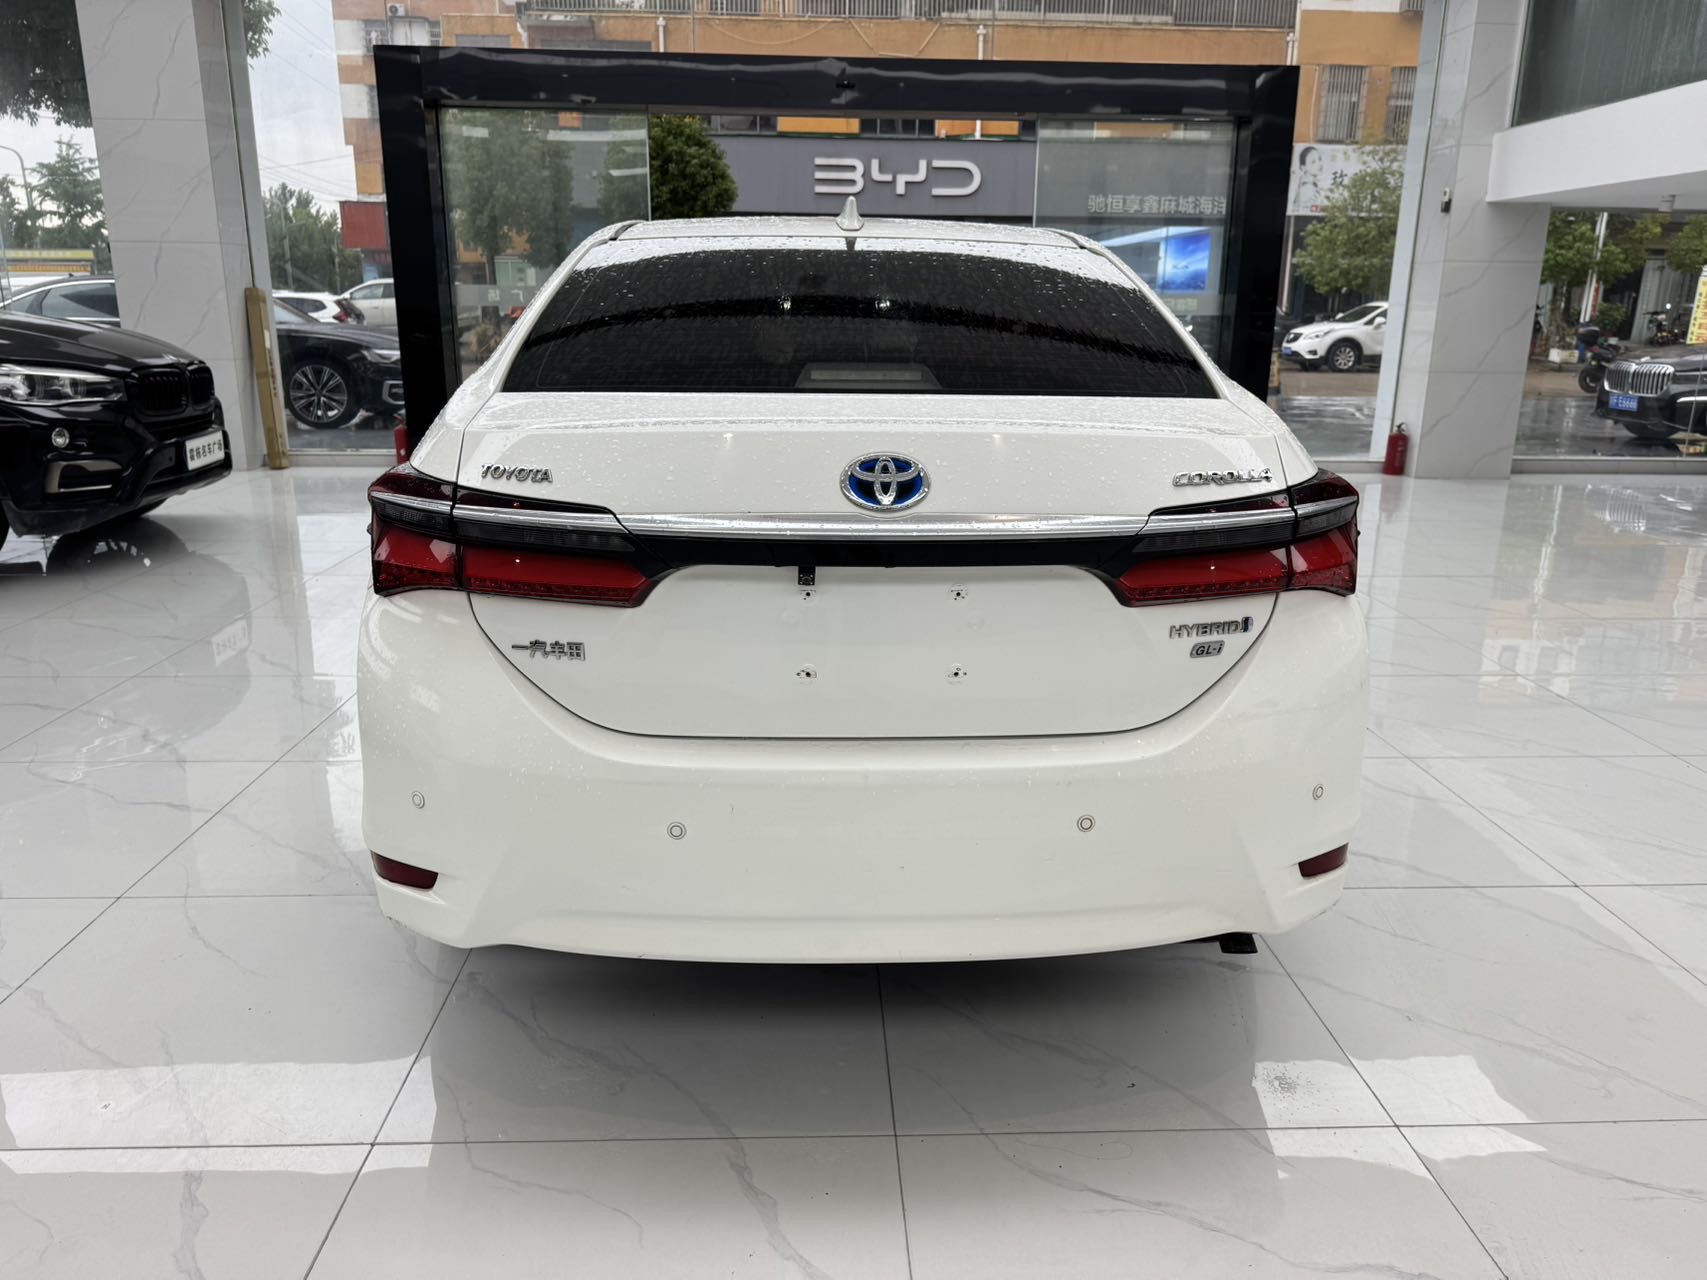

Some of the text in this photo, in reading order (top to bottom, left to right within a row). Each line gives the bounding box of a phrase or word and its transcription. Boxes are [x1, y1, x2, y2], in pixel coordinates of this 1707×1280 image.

[814, 157, 982, 196] BYD
[481, 464, 553, 483] TOYOTA
[1172, 468, 1272, 486] COROLLA
[1195, 643, 1223, 656] GL-i
